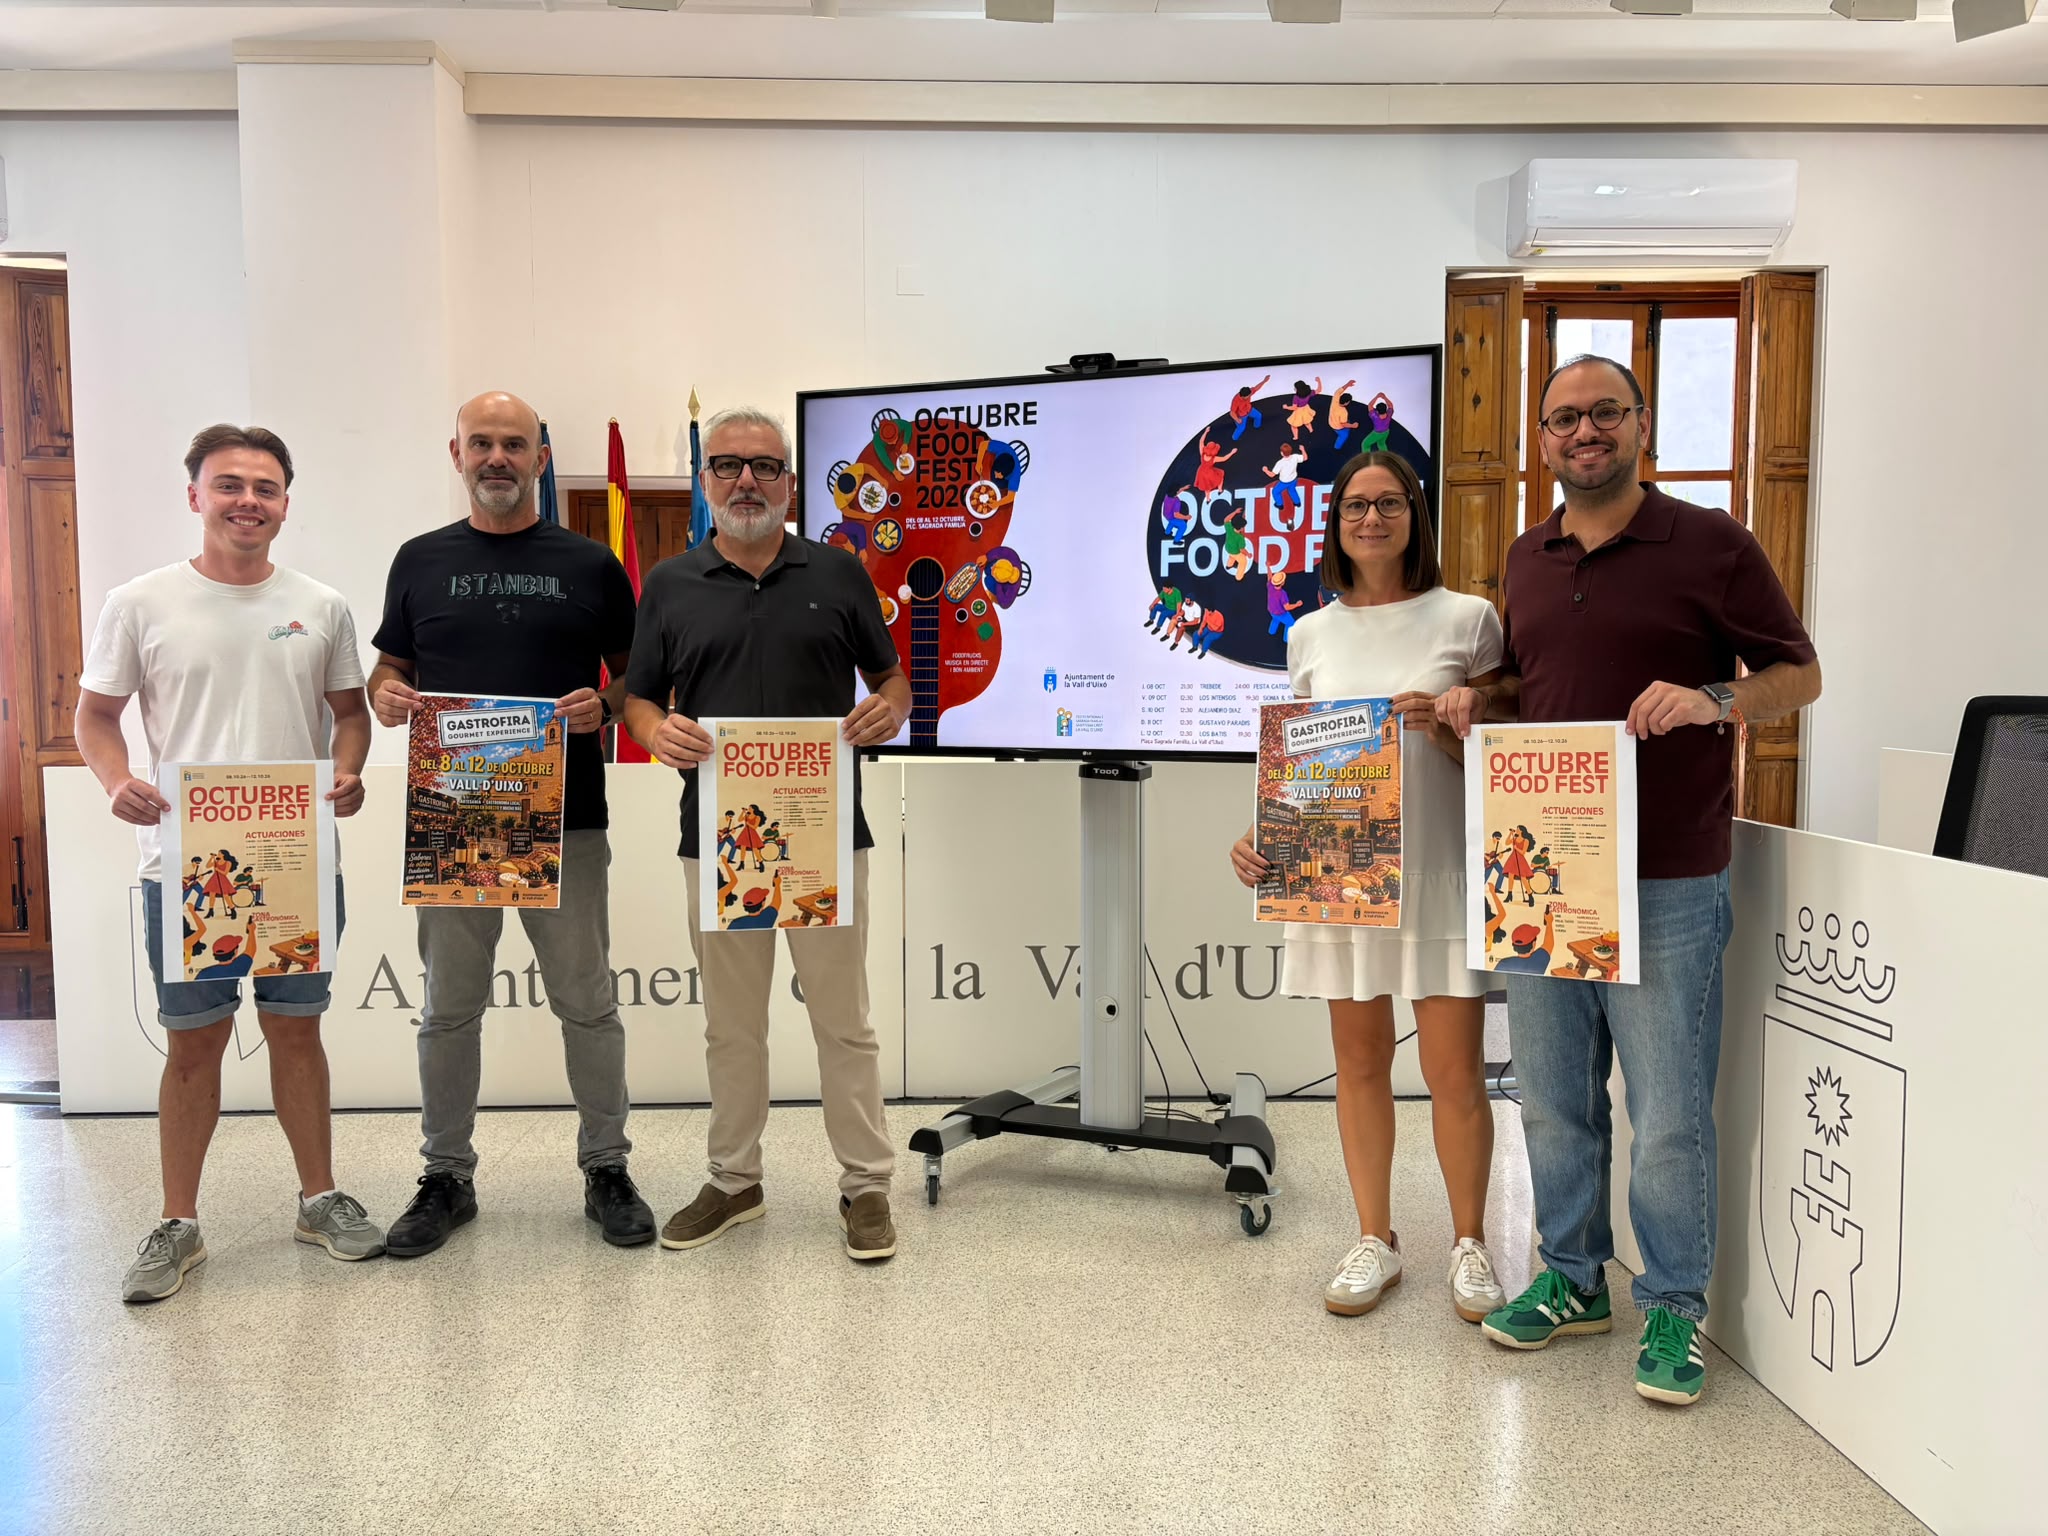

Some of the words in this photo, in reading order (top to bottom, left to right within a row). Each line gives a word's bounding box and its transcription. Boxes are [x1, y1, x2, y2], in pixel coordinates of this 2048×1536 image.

[914, 401, 1037, 432] OCTUBRE
[916, 431, 991, 458] FOOD
[916, 458, 979, 483] FEST
[1161, 484, 1334, 535] OCTUB
[1160, 535, 1290, 578] FOOD
[449, 572, 567, 599] ISTANBUL
[446, 715, 531, 731] GASTROFIRA
[1290, 714, 1367, 739] GASTROFIRA
[448, 731, 483, 740] GOURMET
[486, 727, 531, 737] EXPERIENCE
[1291, 736, 1323, 747] GOURMET
[1325, 728, 1367, 741] EXPERIENCE
[724, 742, 831, 761] OCTUBRE
[420, 759, 437, 770] DEL
[440, 754, 451, 772] 8
[454, 761, 466, 772] AL
[467, 756, 486, 772] 12
[487, 763, 499, 772] DE
[501, 762, 553, 775] OCTUBRE
[724, 761, 779, 777] FOOD
[785, 761, 831, 777] FEST
[1267, 769, 1282, 780] DEL
[1285, 763, 1294, 780] 8
[1297, 769, 1307, 779] AL
[1308, 762, 1324, 780] 12
[1326, 767, 1337, 778] DE
[1340, 765, 1389, 779] OCTUBRE
[1490, 751, 1609, 774] OCTUBRE
[449, 779, 479, 791] VALL
[773, 787, 827, 795] ACTUACIONES
[1292, 786, 1320, 799] VALL
[1490, 774, 1549, 794] FOOD
[1555, 774, 1609, 794] FEST
[189, 785, 310, 806] OCTUBRE
[189, 805, 253, 823] FOOD
[258, 803, 310, 821] FEST
[1541, 806, 1604, 815] ACTUACIONES
[245, 830, 305, 839] ACTUACIONES
[408, 852, 432, 862] Sabores
[930, 944, 985, 1001] la
